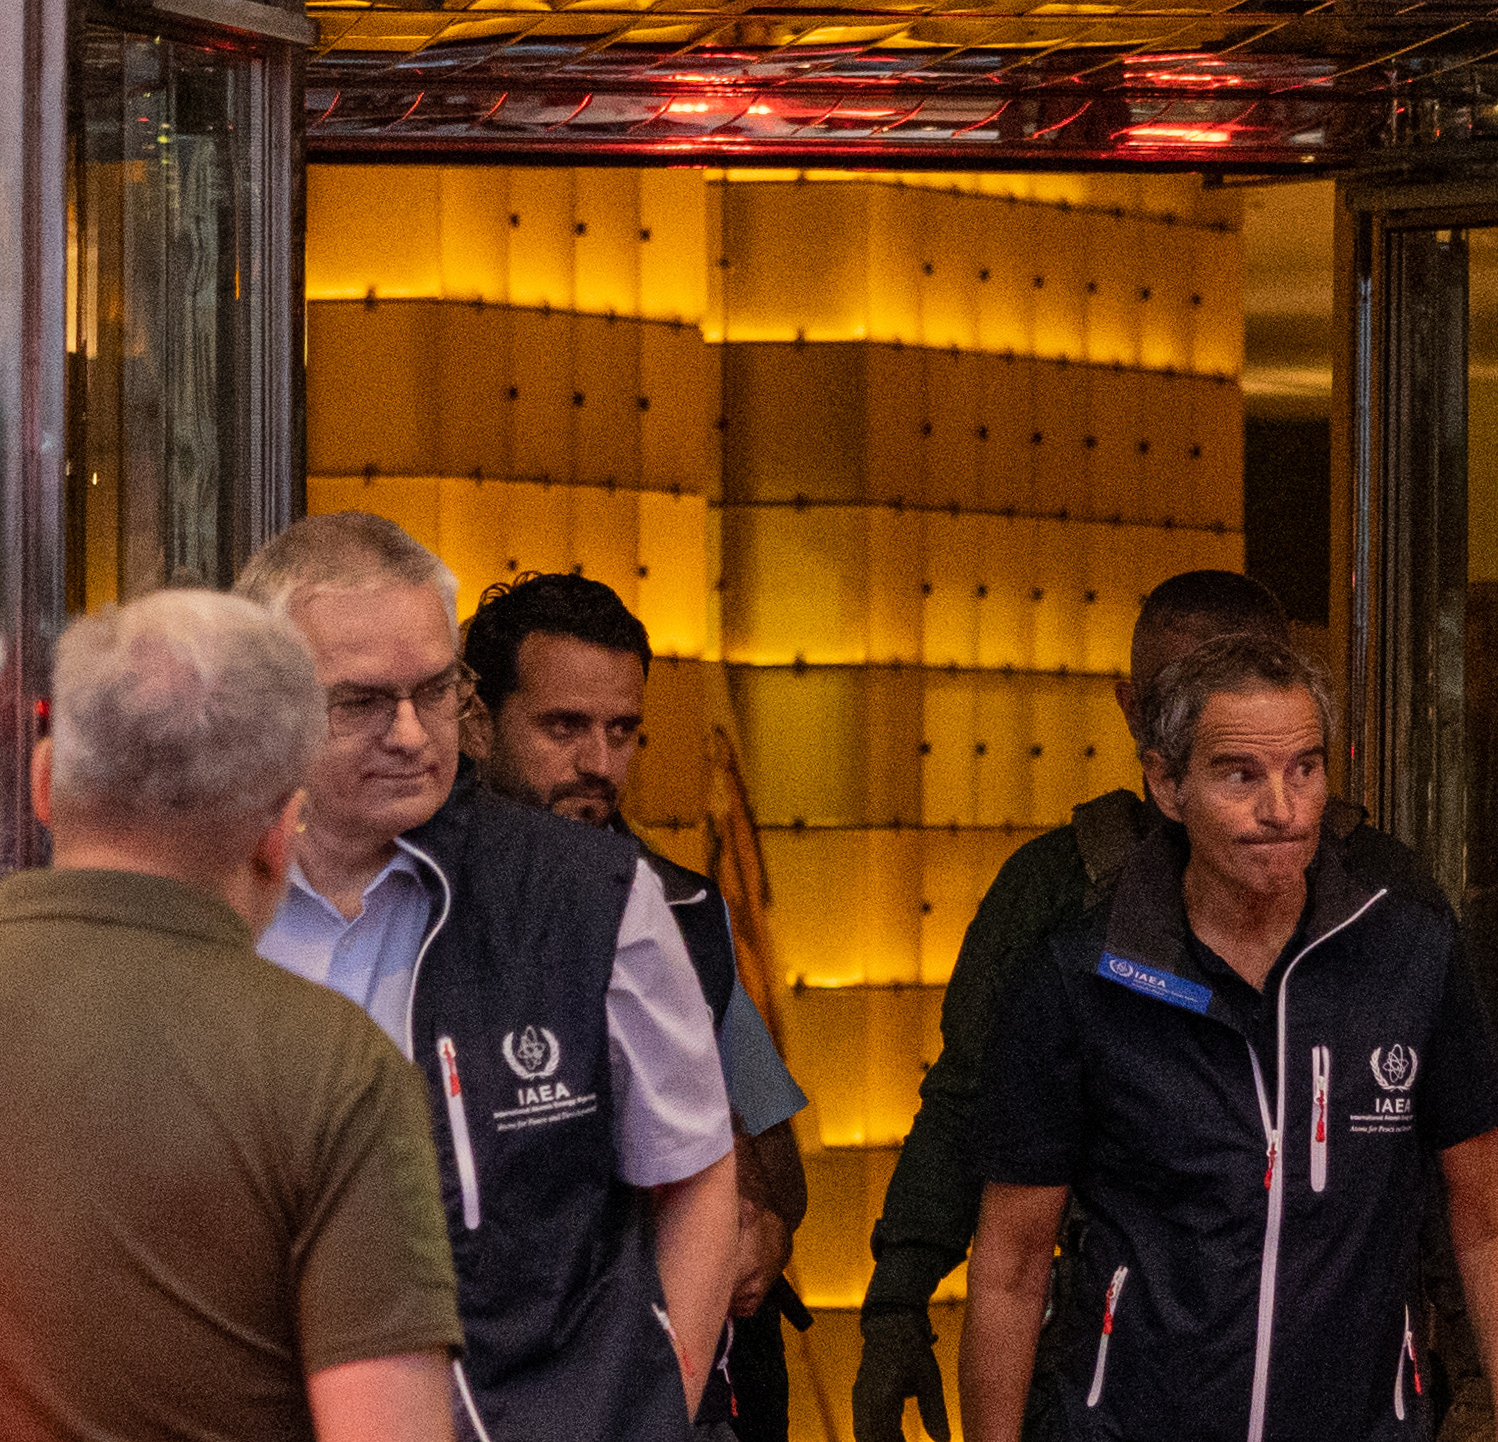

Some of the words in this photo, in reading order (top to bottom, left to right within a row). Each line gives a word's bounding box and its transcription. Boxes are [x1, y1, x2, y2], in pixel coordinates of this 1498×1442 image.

[1133, 971, 1167, 988] IAEA
[517, 1081, 571, 1106] IAEA
[1375, 1097, 1411, 1113] IAEA
